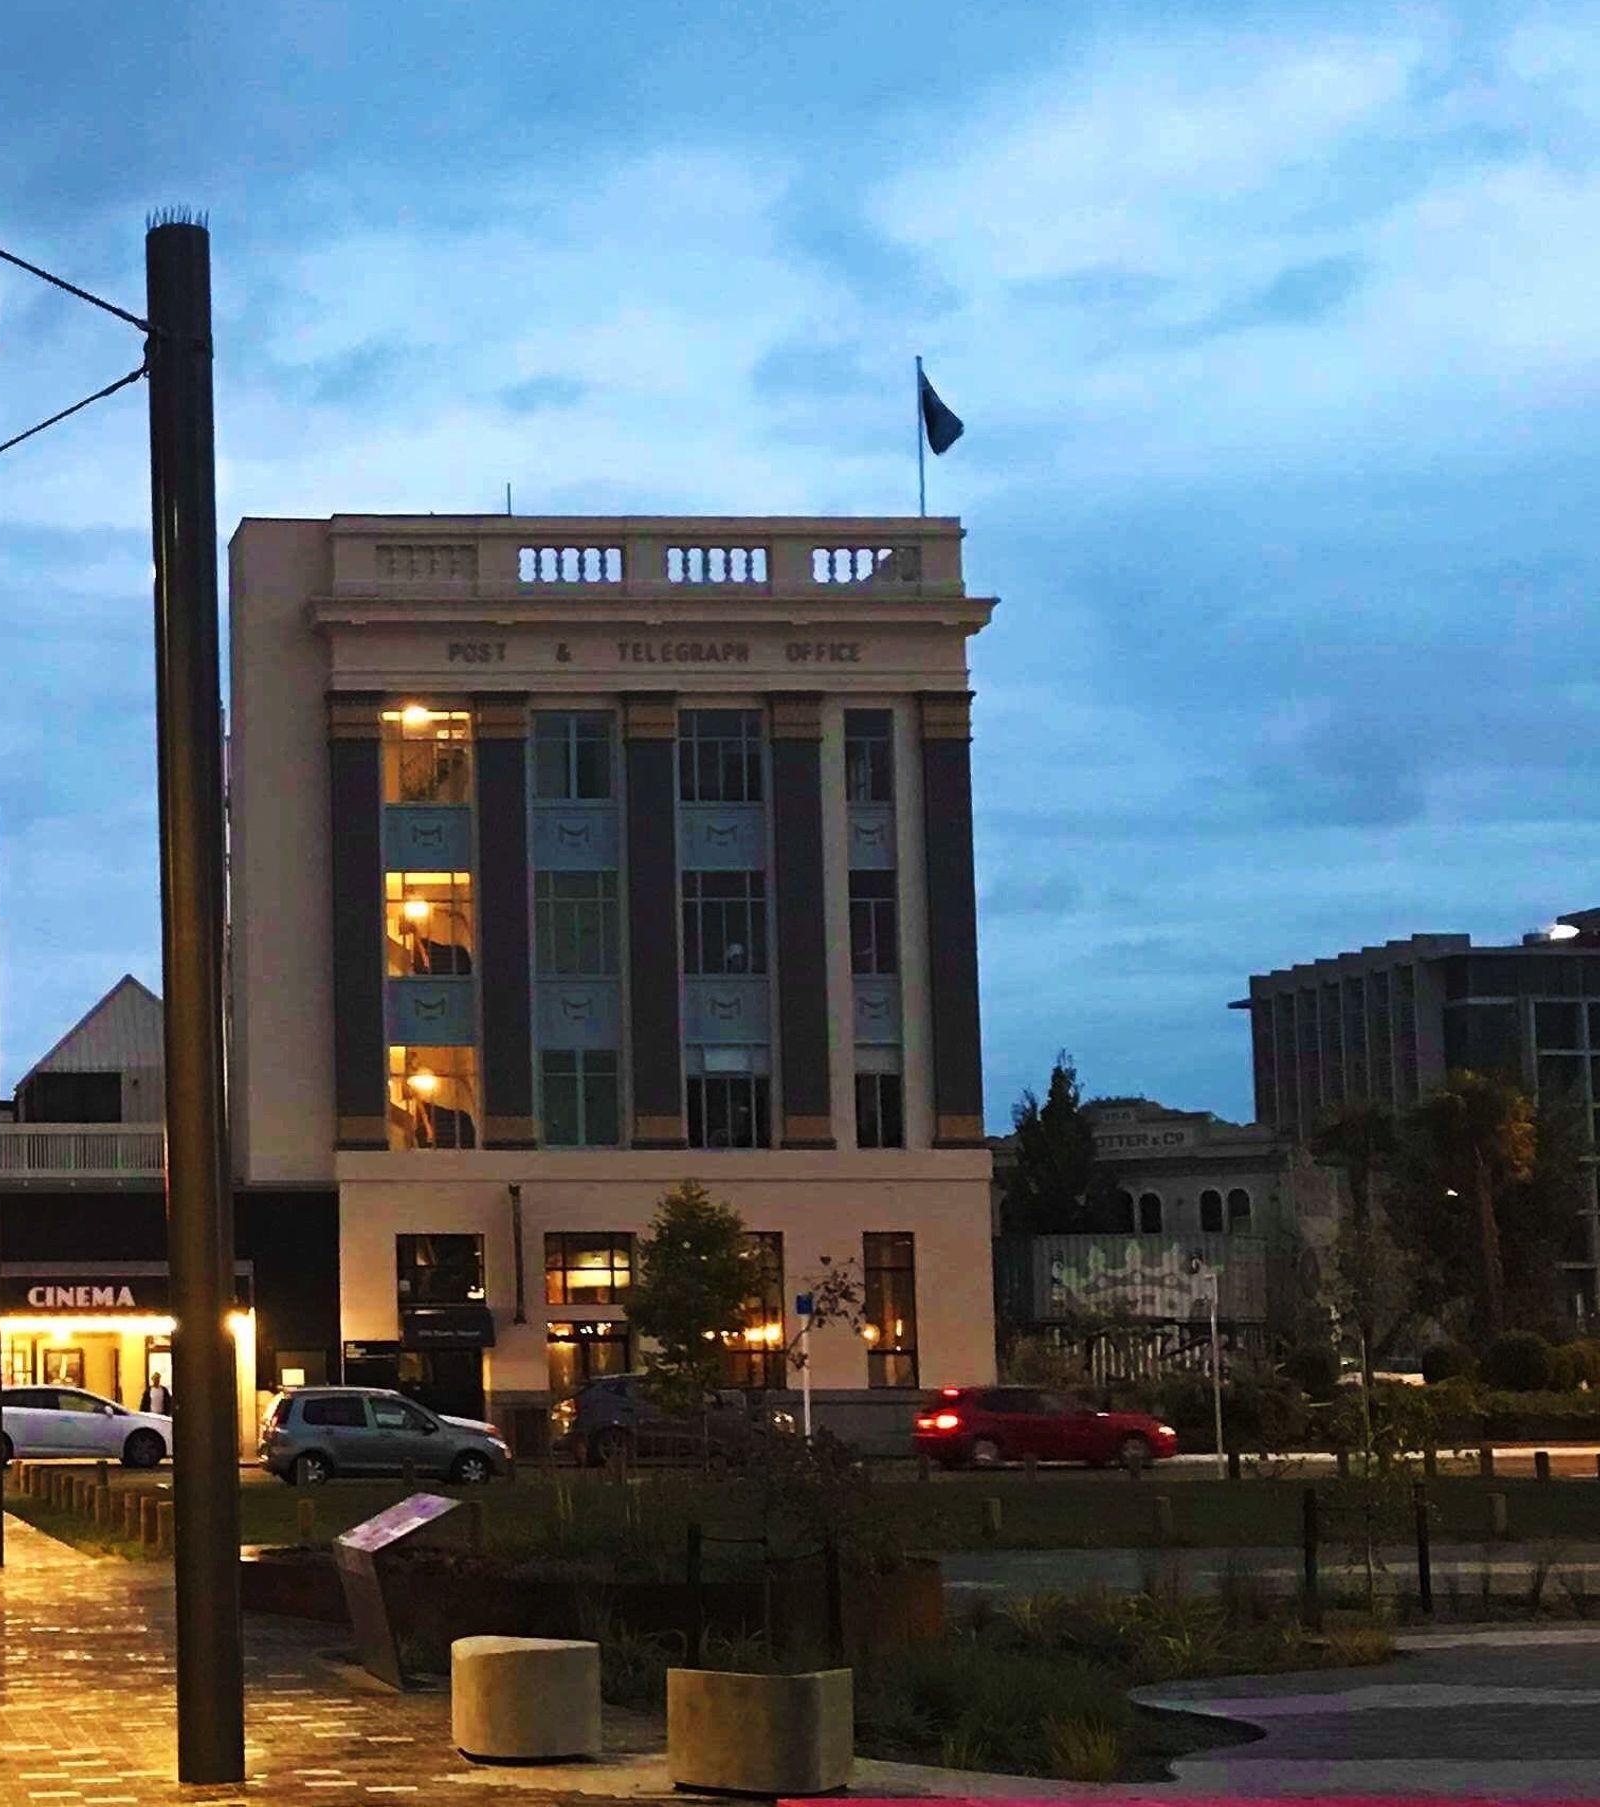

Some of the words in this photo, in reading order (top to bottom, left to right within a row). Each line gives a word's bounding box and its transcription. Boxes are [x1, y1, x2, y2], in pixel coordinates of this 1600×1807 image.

[449, 643, 506, 662] POST
[556, 643, 571, 662] &
[617, 643, 749, 662] TELEGRAPH
[785, 643, 861, 662] OFFICE
[27, 1286, 136, 1307] CINEMA
